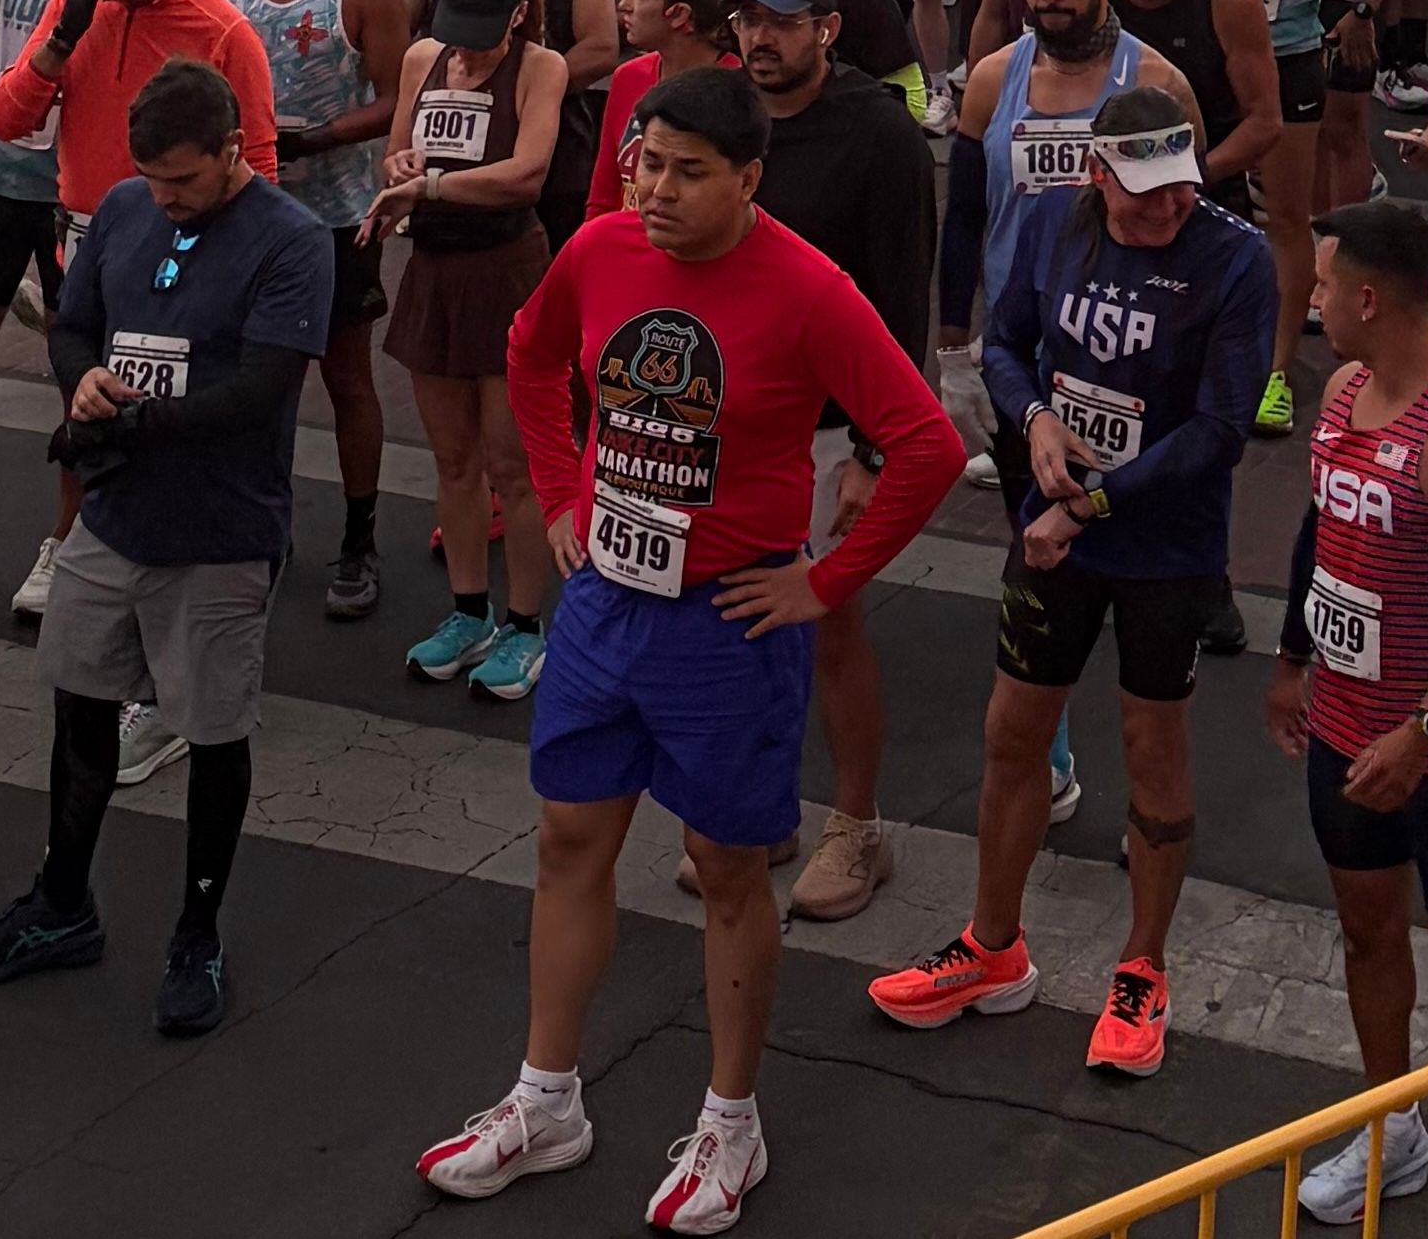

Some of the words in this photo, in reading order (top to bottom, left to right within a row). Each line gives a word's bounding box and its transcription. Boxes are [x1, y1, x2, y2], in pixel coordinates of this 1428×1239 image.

[423, 110, 477, 141] 1901
[1023, 142, 1090, 174] 1867
[650, 331, 686, 350] ROUTE
[1058, 292, 1157, 363] USA
[113, 359, 176, 399] 1628
[641, 351, 678, 384] 66
[1060, 401, 1129, 453] 1549
[596, 442, 709, 489] MARATHON
[650, 440, 704, 467] CITY
[1311, 454, 1393, 535] USA
[596, 513, 671, 572] 4519
[1313, 598, 1366, 654] 1759
